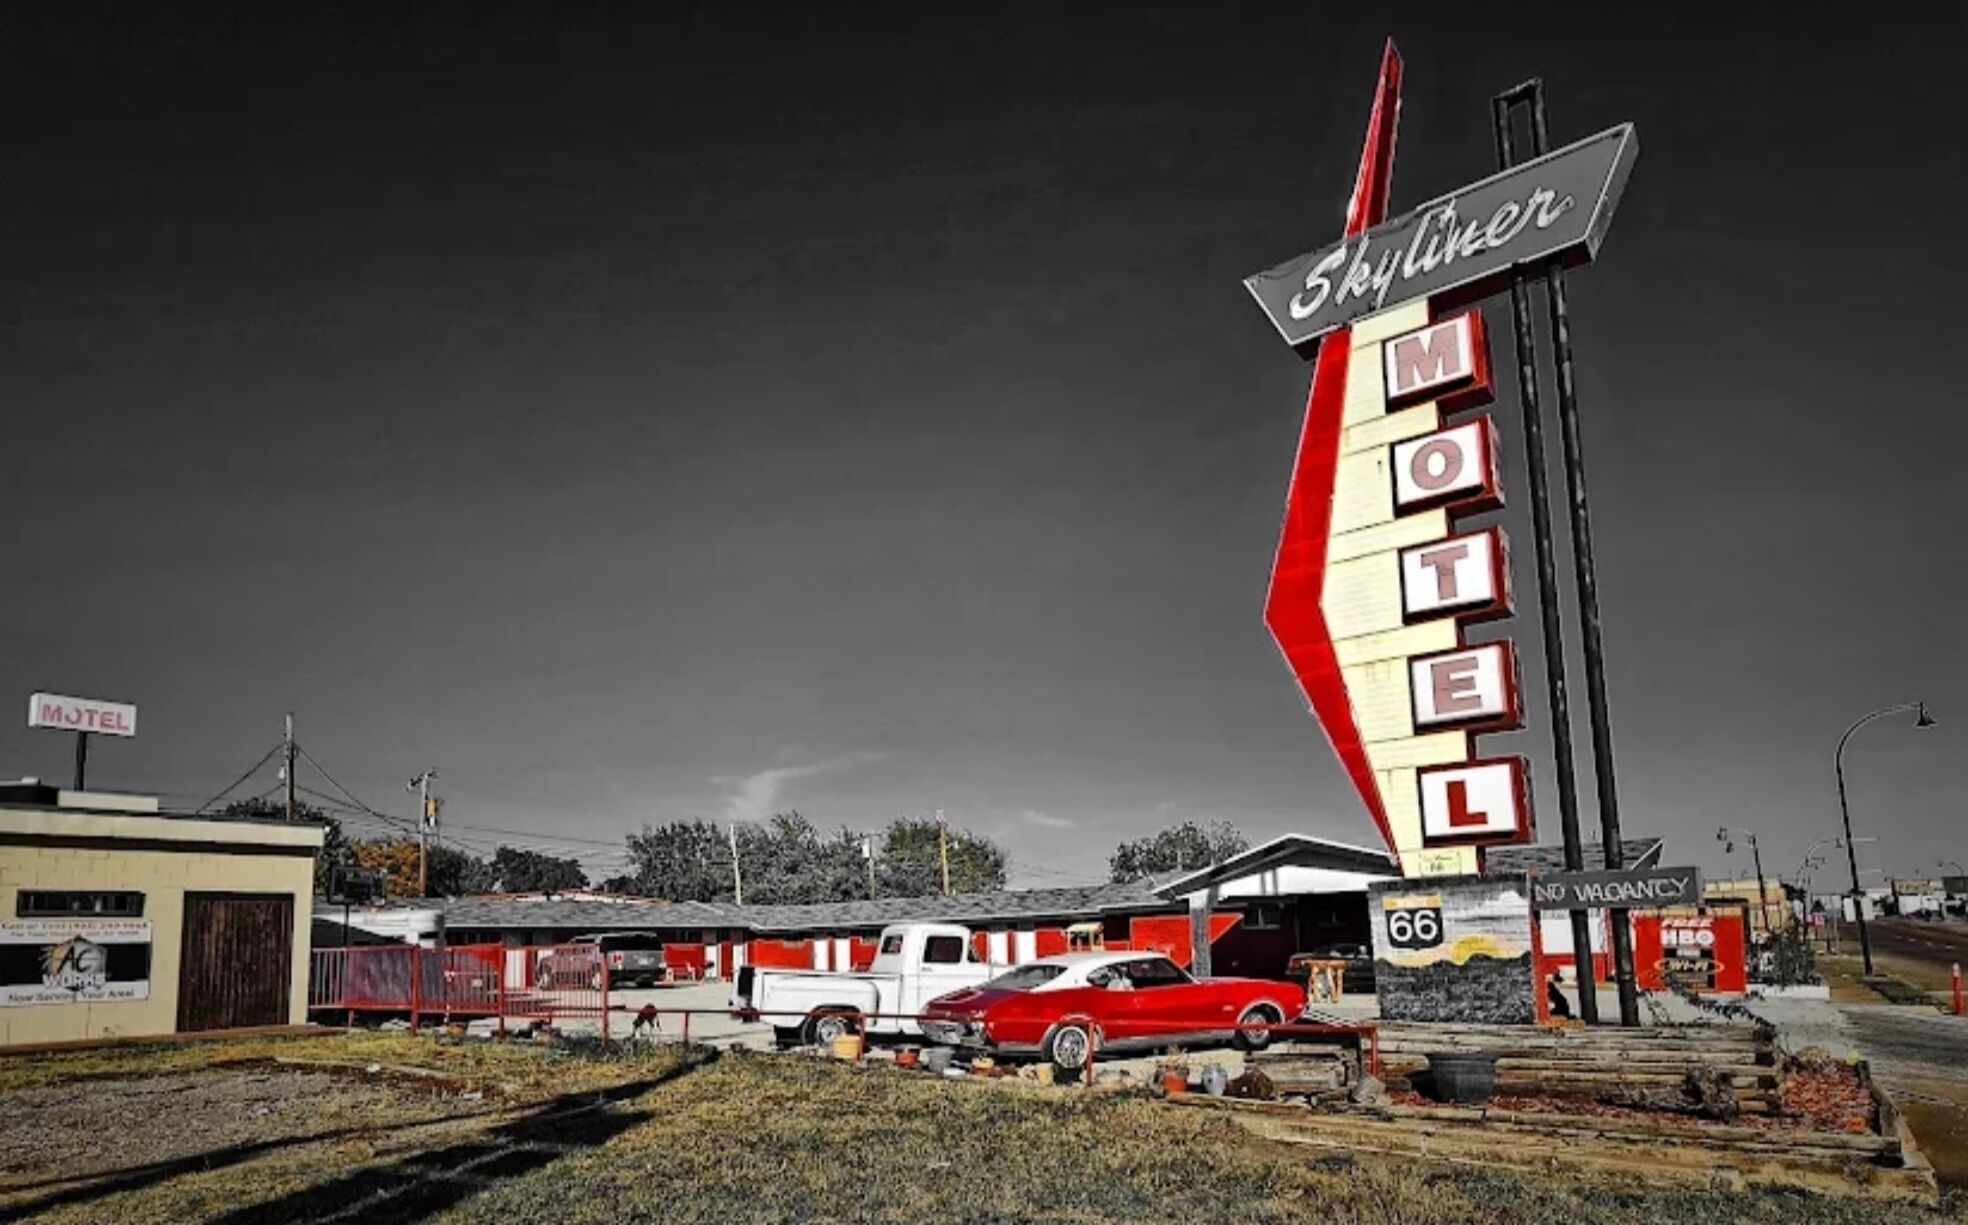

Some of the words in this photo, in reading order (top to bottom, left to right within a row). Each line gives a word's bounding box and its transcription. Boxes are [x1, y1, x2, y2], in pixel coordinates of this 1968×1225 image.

[1289, 185, 1575, 320] Skyliner
[1393, 323, 1490, 829] MOTEL
[42, 704, 130, 731] MOTEL
[1535, 883, 1565, 901] NO
[1390, 910, 1438, 942] 66
[1661, 928, 1715, 949] HBO
[57, 944, 92, 975] AC
